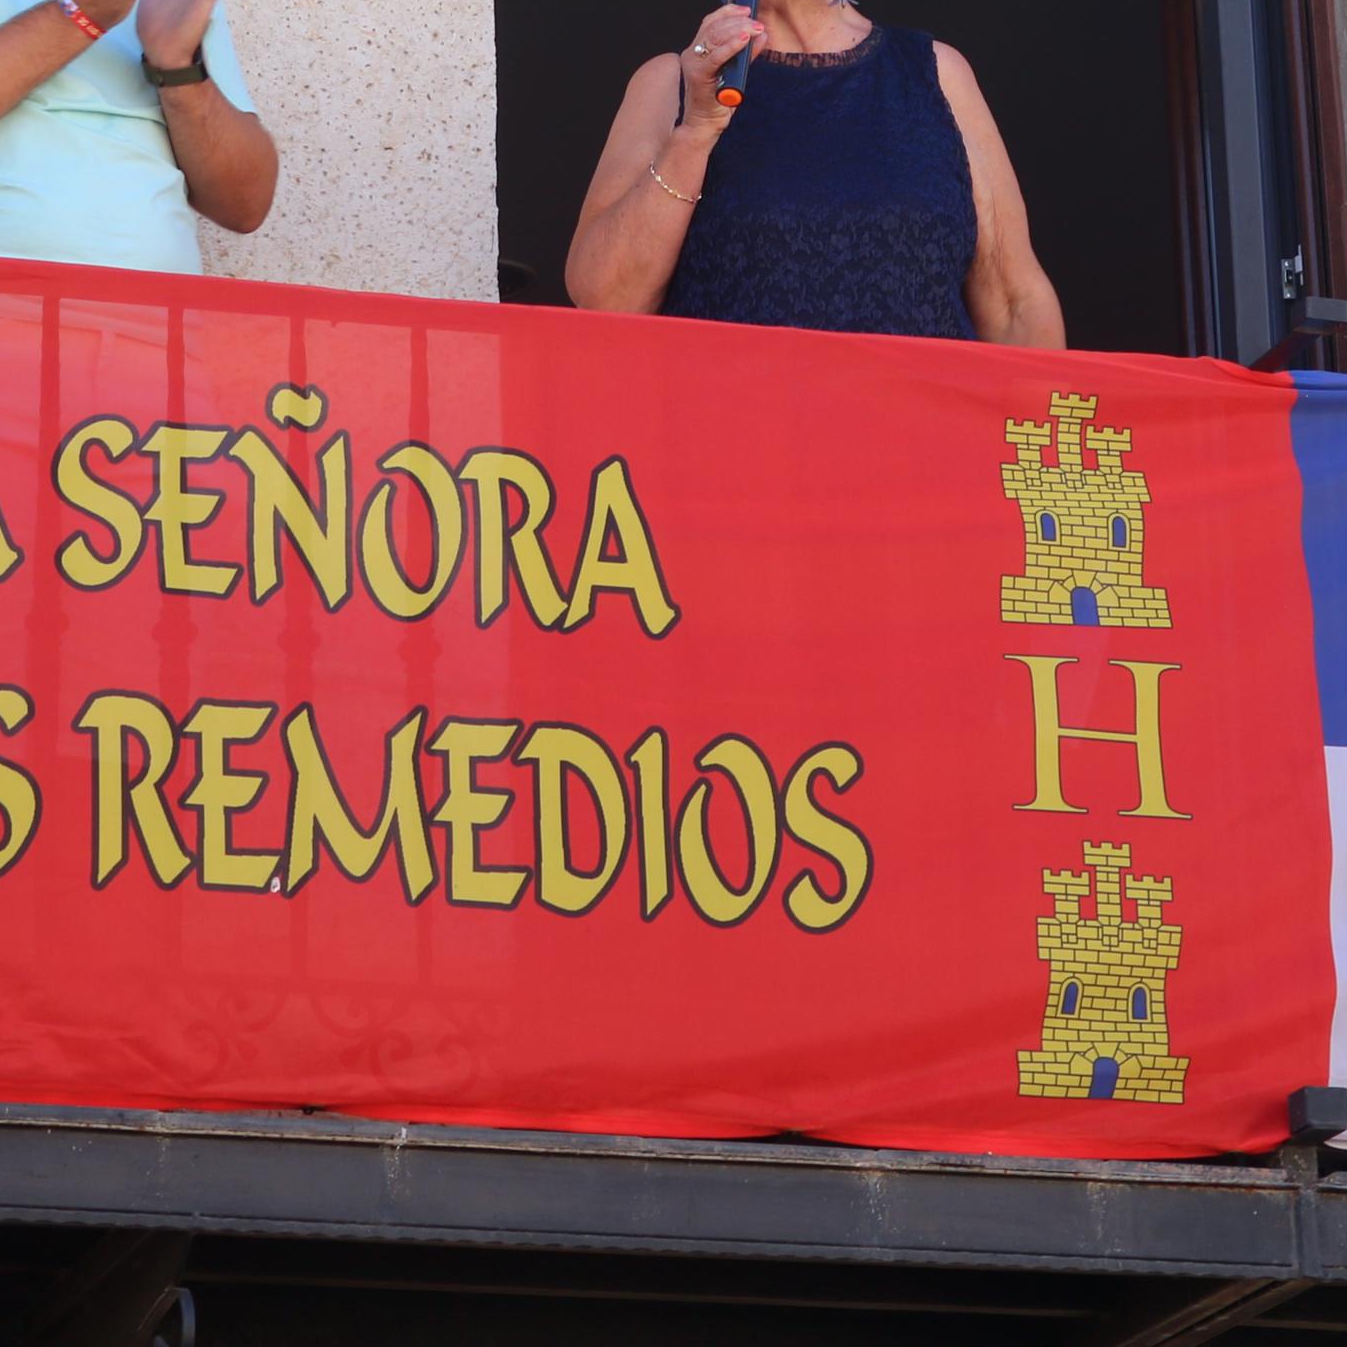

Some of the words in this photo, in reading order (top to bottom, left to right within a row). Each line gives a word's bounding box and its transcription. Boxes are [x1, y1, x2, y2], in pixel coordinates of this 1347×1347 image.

[52, 381, 682, 640] SEÑORA
[72, 689, 874, 933] REMEDIOS
[1003, 653, 1193, 821] H
